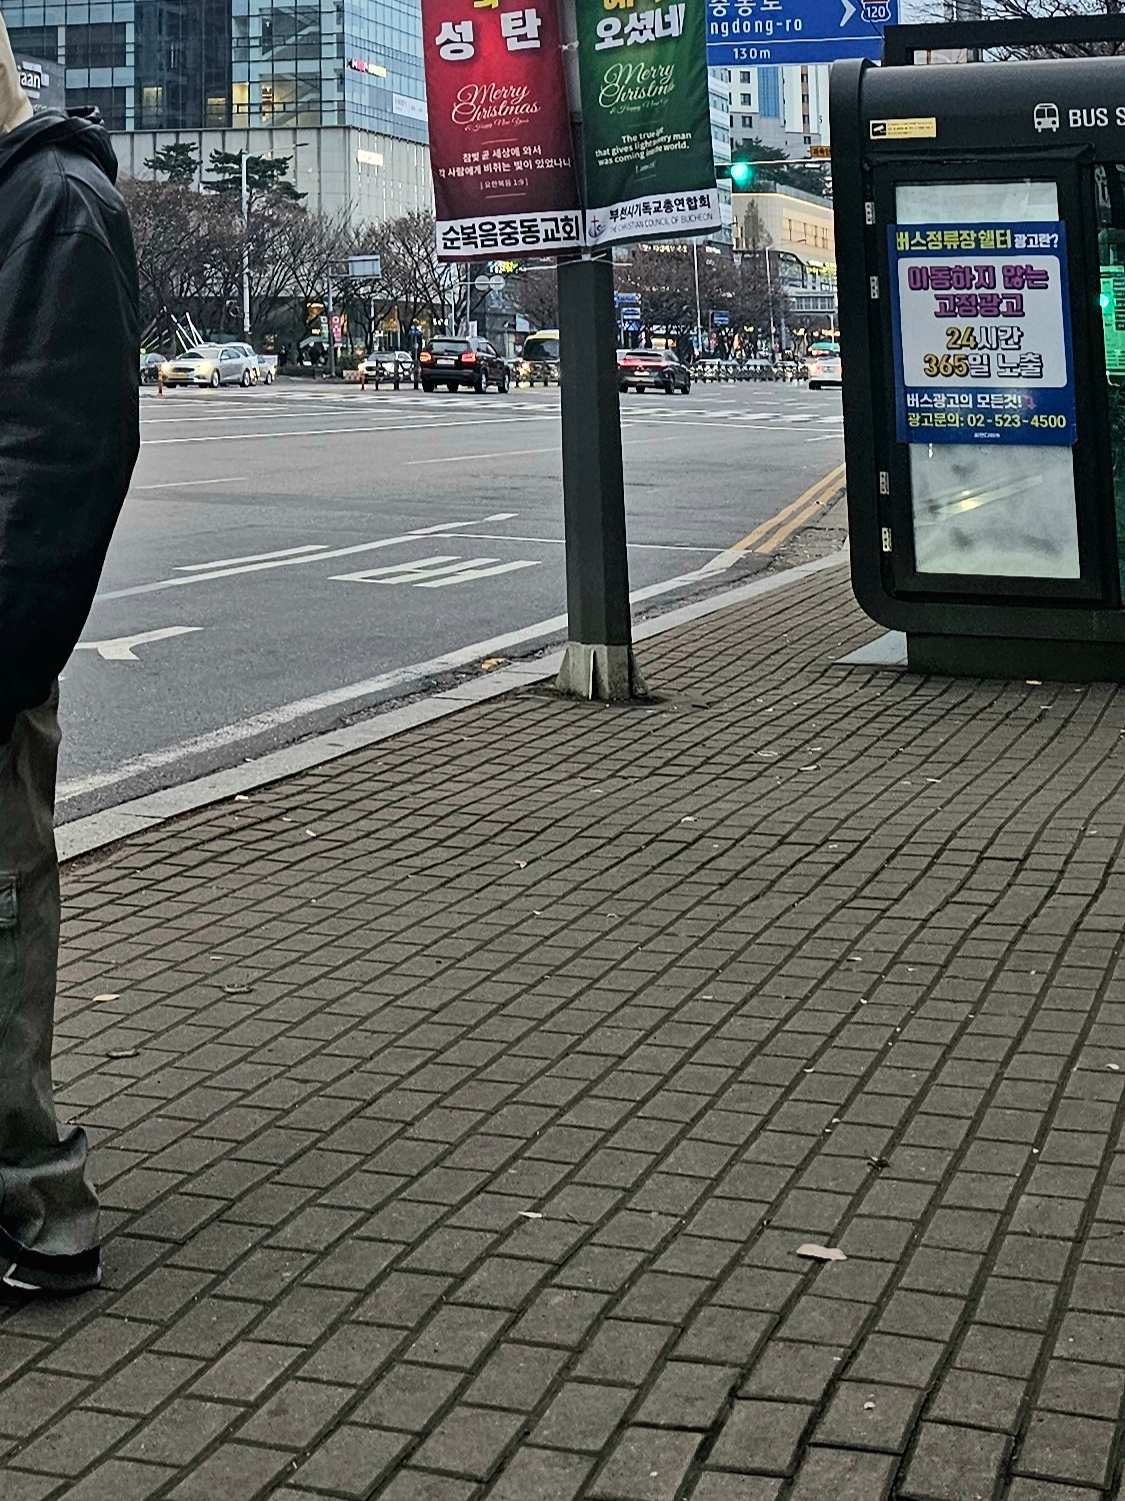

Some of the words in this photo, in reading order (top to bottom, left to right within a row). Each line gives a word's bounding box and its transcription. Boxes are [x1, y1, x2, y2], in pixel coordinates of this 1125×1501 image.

[866, 6, 886, 19] 120
[594, 3, 686, 51] 오셨네
[710, 17, 803, 37] ngdong-ro
[733, 46, 771, 61] 130m
[603, 61, 675, 86] Merry
[457, 82, 531, 106] Merry
[598, 79, 675, 108] Christm
[451, 99, 541, 125] Christmas
[1068, 107, 1109, 128] BUS
[595, 148, 610, 157] that
[611, 145, 633, 157] gives
[673, 132, 692, 141] man
[621, 134, 638, 144] The
[492, 146, 521, 160] 세상에
[522, 145, 542, 156] 와서
[597, 157, 614, 166] was
[614, 151, 646, 164] coming
[663, 140, 690, 151] world.
[447, 164, 482, 177] 사람에게
[442, 215, 580, 250] 순복음중동교회
[896, 231, 975, 251] 버스정류장
[978, 230, 1011, 249] 쉘터
[1014, 233, 1059, 248] 광고란?
[907, 265, 996, 290] 이동하지
[1002, 264, 1050, 290] 않는
[934, 293, 1025, 317] 고정광고
[946, 325, 1024, 350] 24시간
[923, 353, 992, 378] 365일
[996, 352, 1043, 378] 노출
[906, 393, 973, 409] 버스광고의
[977, 393, 1023, 409] 모든것!
[908, 412, 964, 428] 광고문의:
